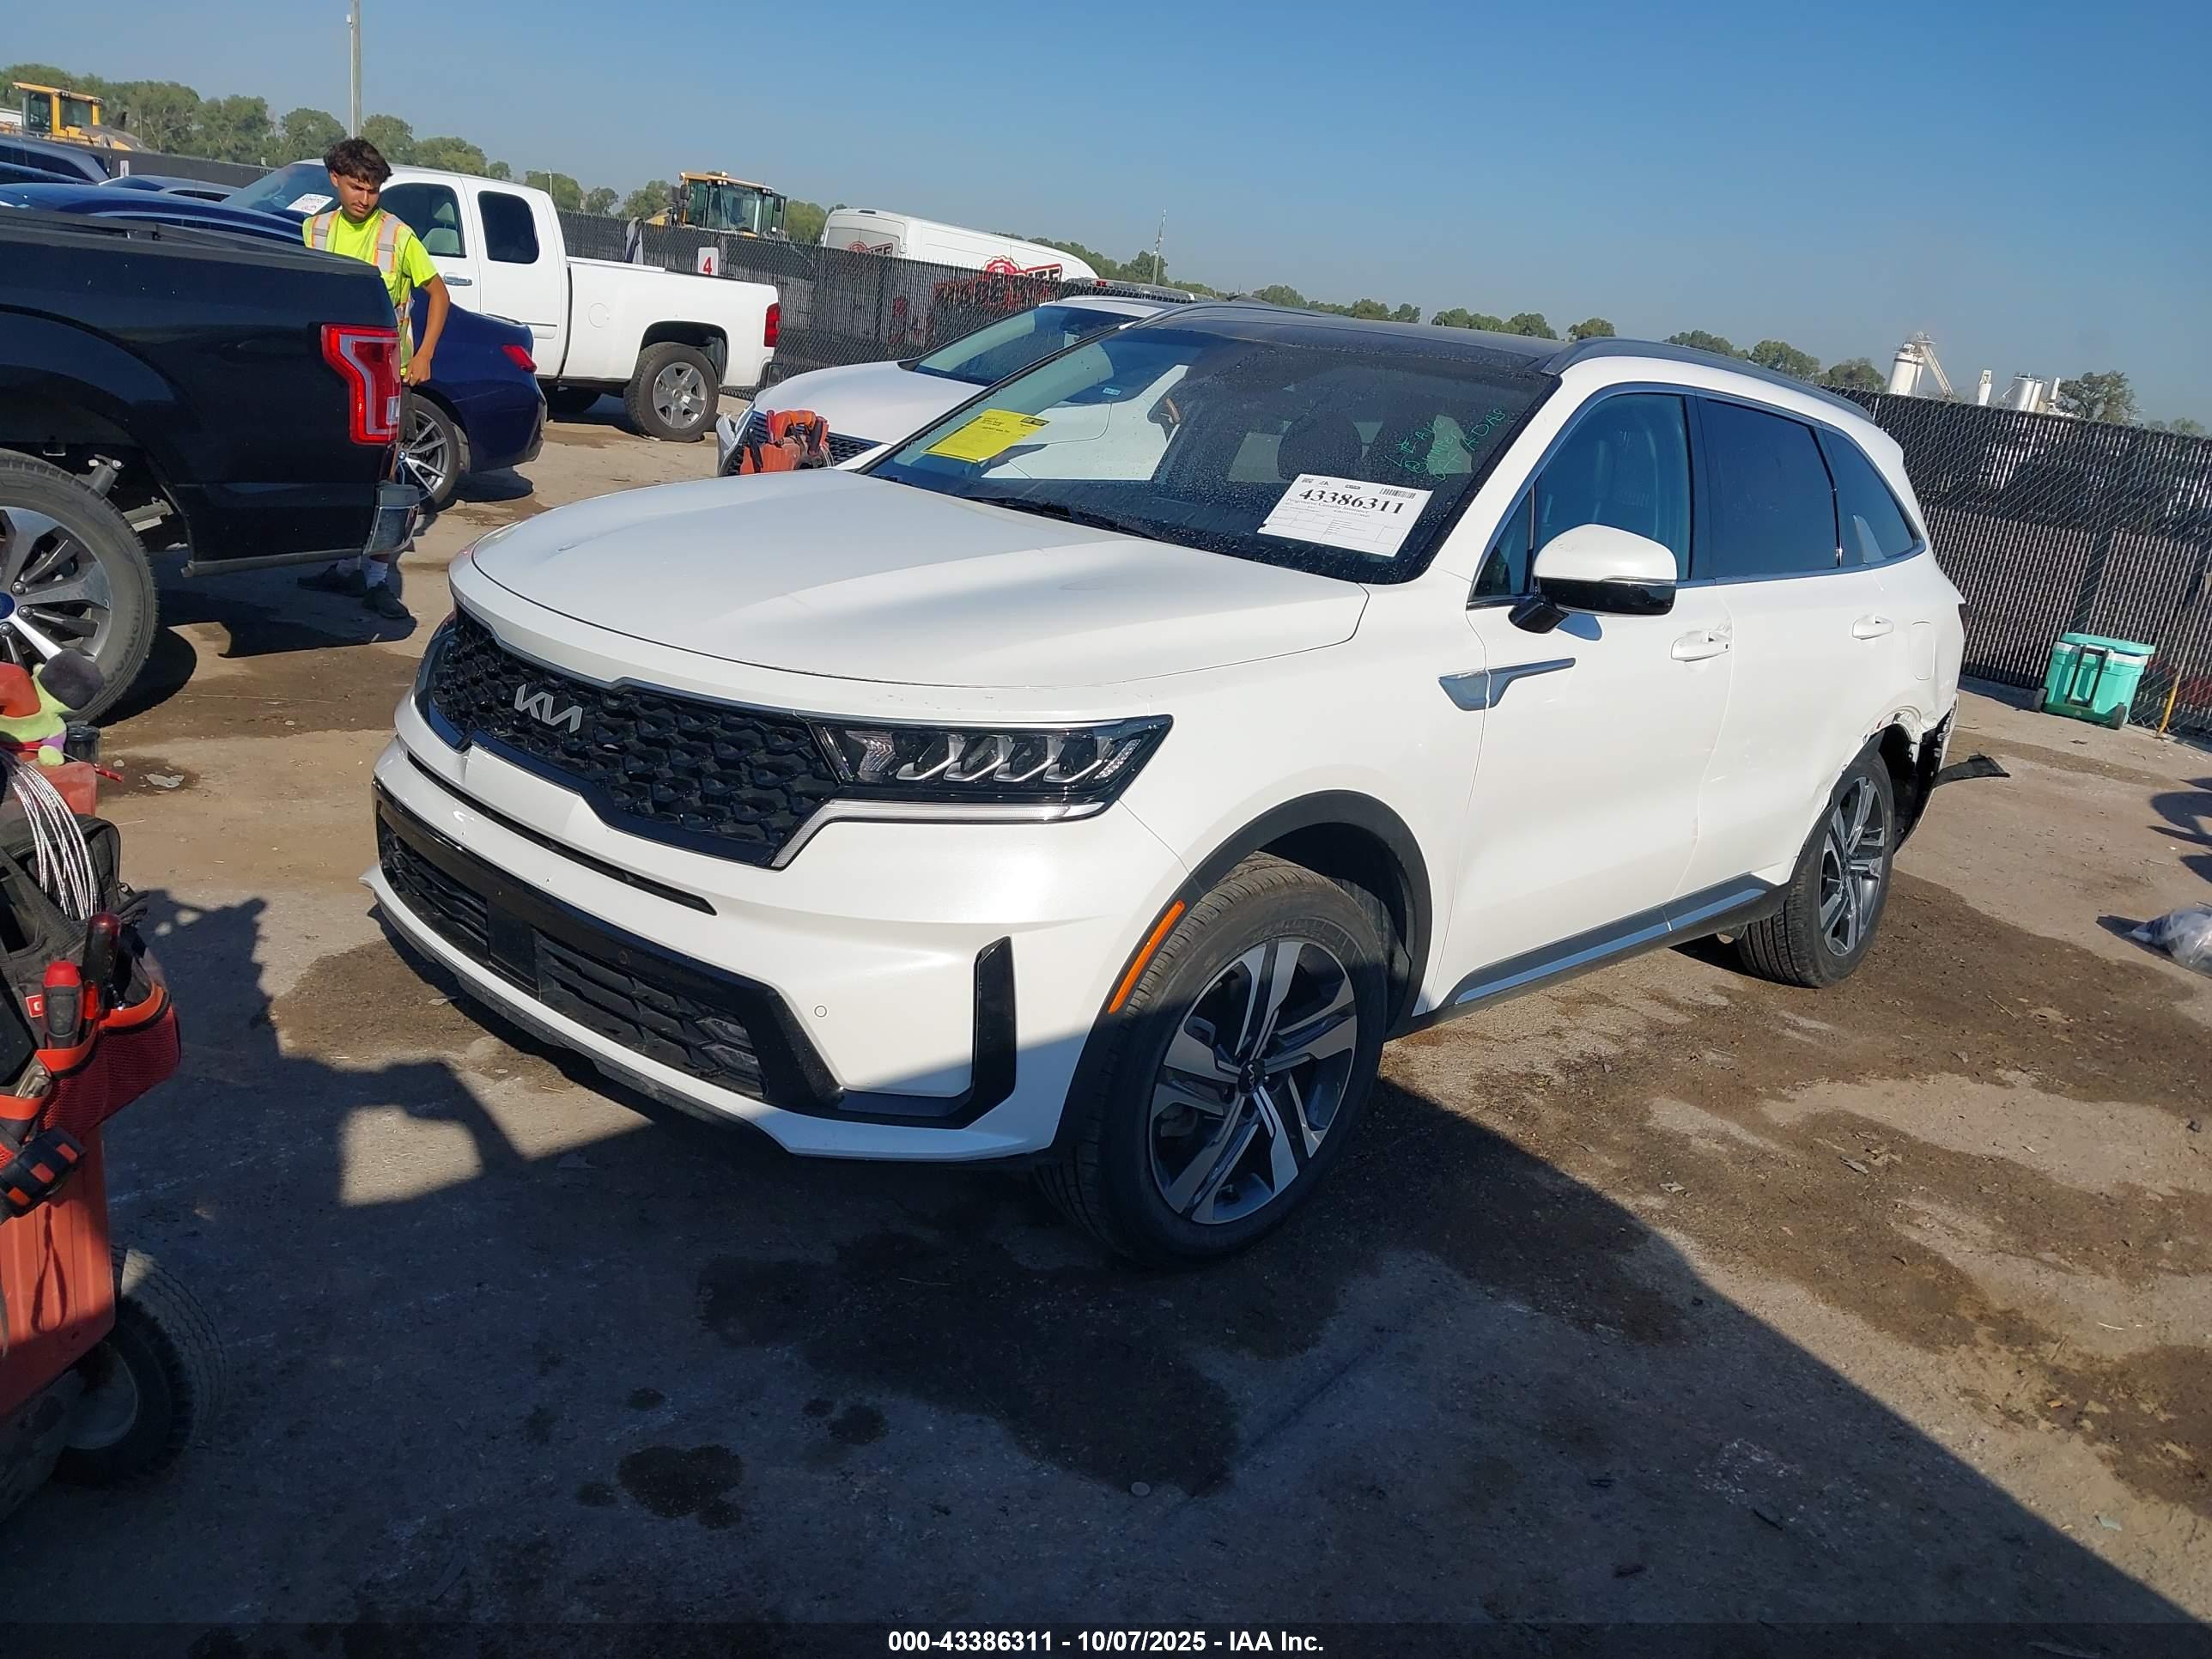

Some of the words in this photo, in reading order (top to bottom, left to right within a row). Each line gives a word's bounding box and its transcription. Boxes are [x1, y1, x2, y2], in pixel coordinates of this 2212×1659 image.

[702, 256, 713, 275] 4
[1462, 408, 1506, 452] ADAS
[1298, 489, 1404, 514] 43386311
[514, 684, 583, 733] KIA
